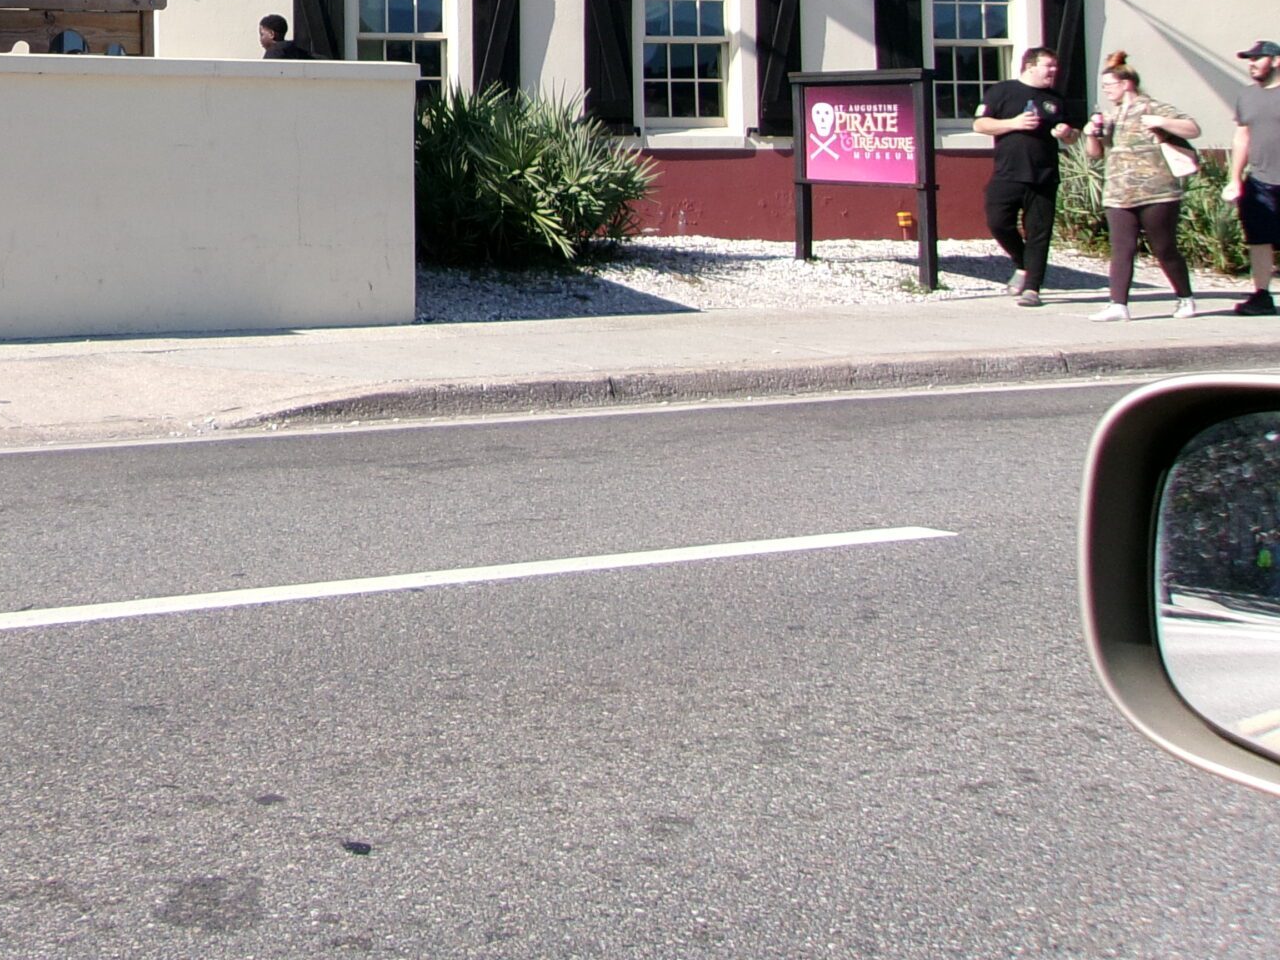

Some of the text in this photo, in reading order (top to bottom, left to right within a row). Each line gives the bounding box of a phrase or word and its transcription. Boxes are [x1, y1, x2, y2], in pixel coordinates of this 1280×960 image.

[848, 103, 898, 112] AUGUSTINE
[834, 111, 898, 135] PIRATE
[851, 132, 915, 152] TREASURE
[853, 152, 914, 160] MUSEUM
